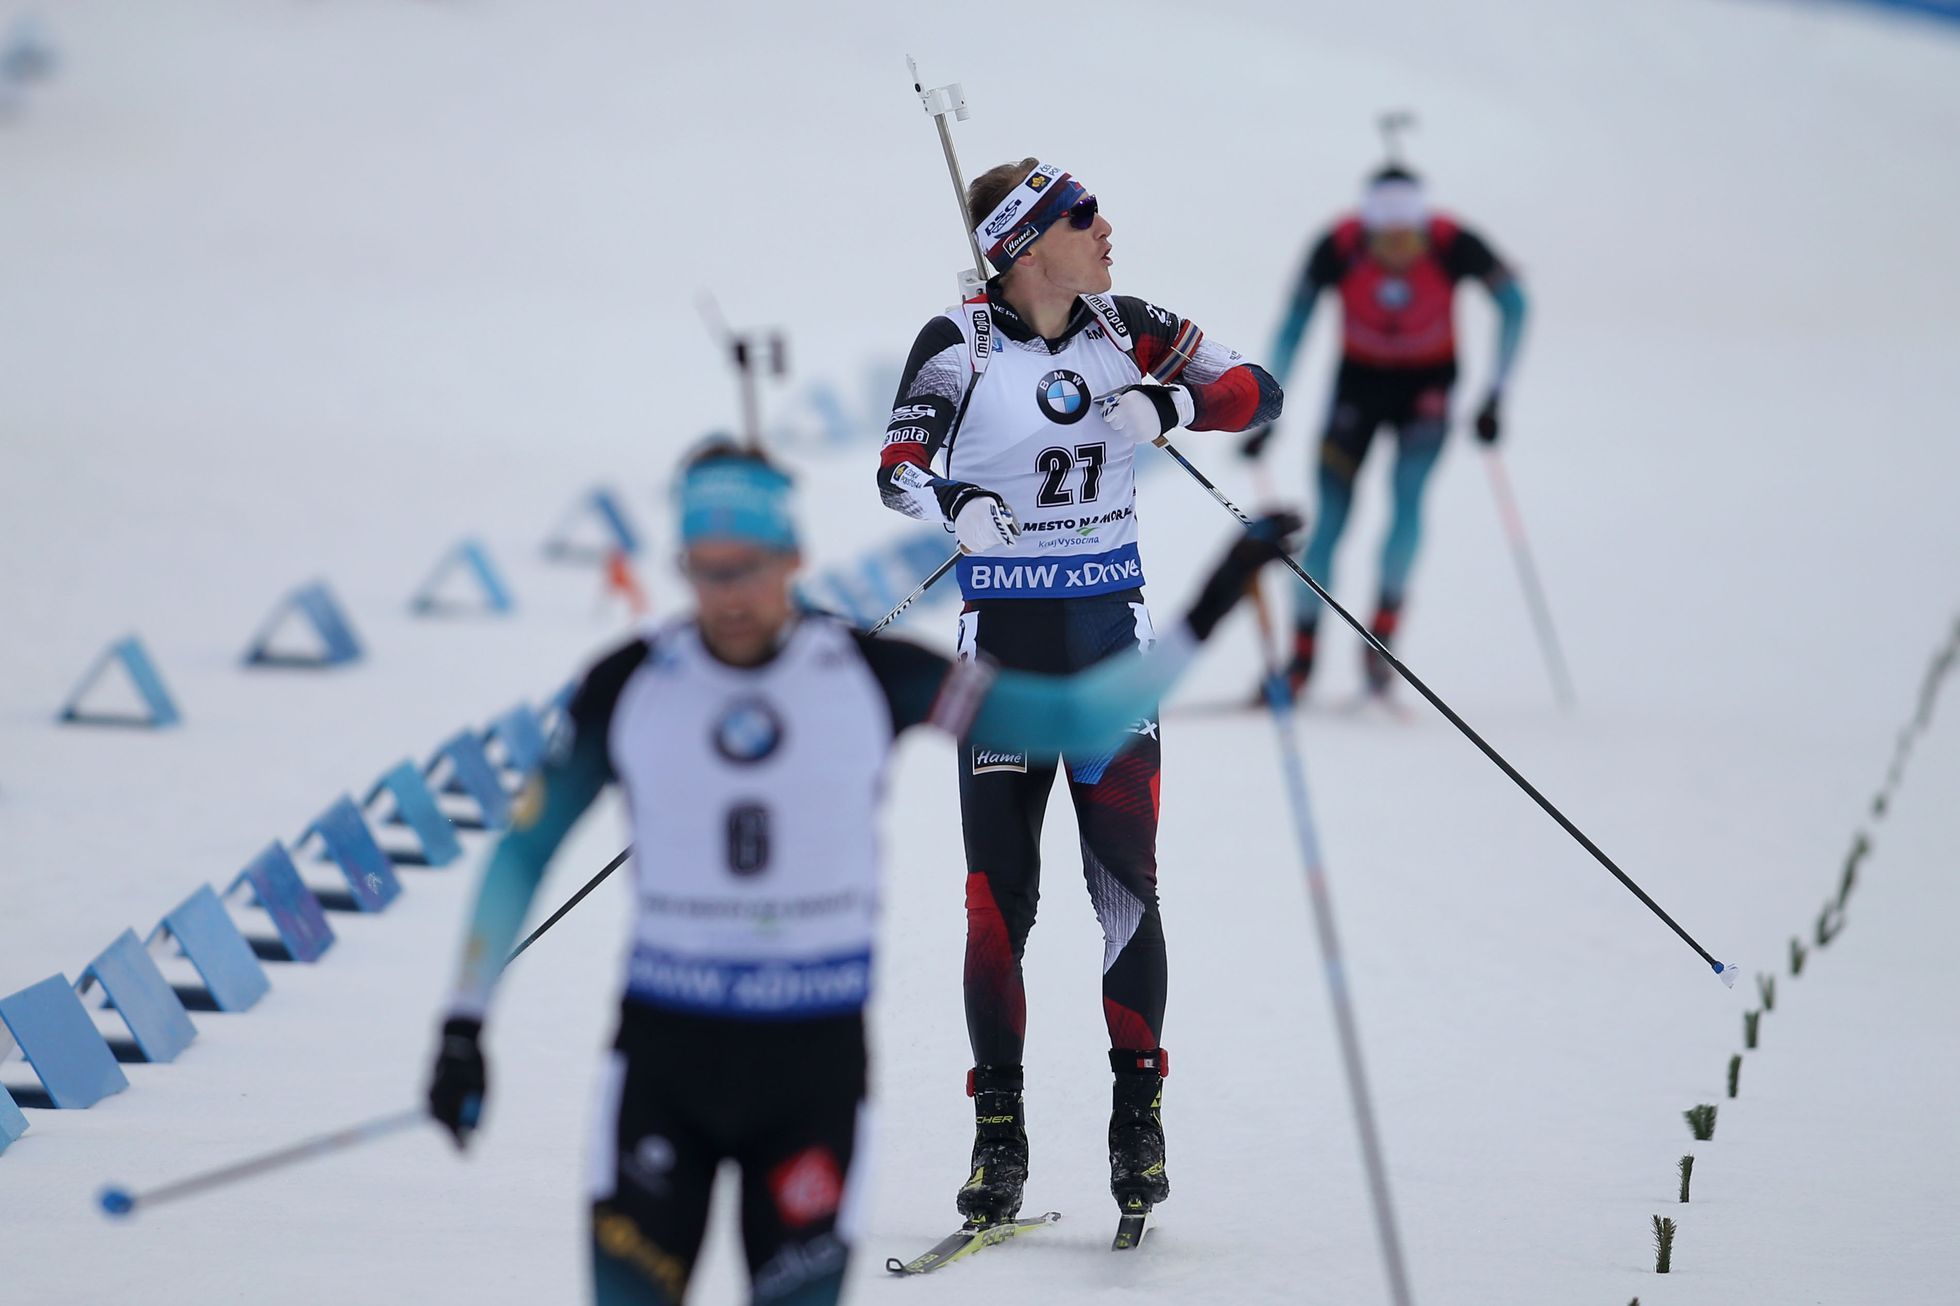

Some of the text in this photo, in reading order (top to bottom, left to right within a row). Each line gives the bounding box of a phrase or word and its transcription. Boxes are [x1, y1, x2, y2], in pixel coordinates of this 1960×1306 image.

[1035, 441, 1106, 508] 27
[971, 558, 1140, 589] BMW xDrive
